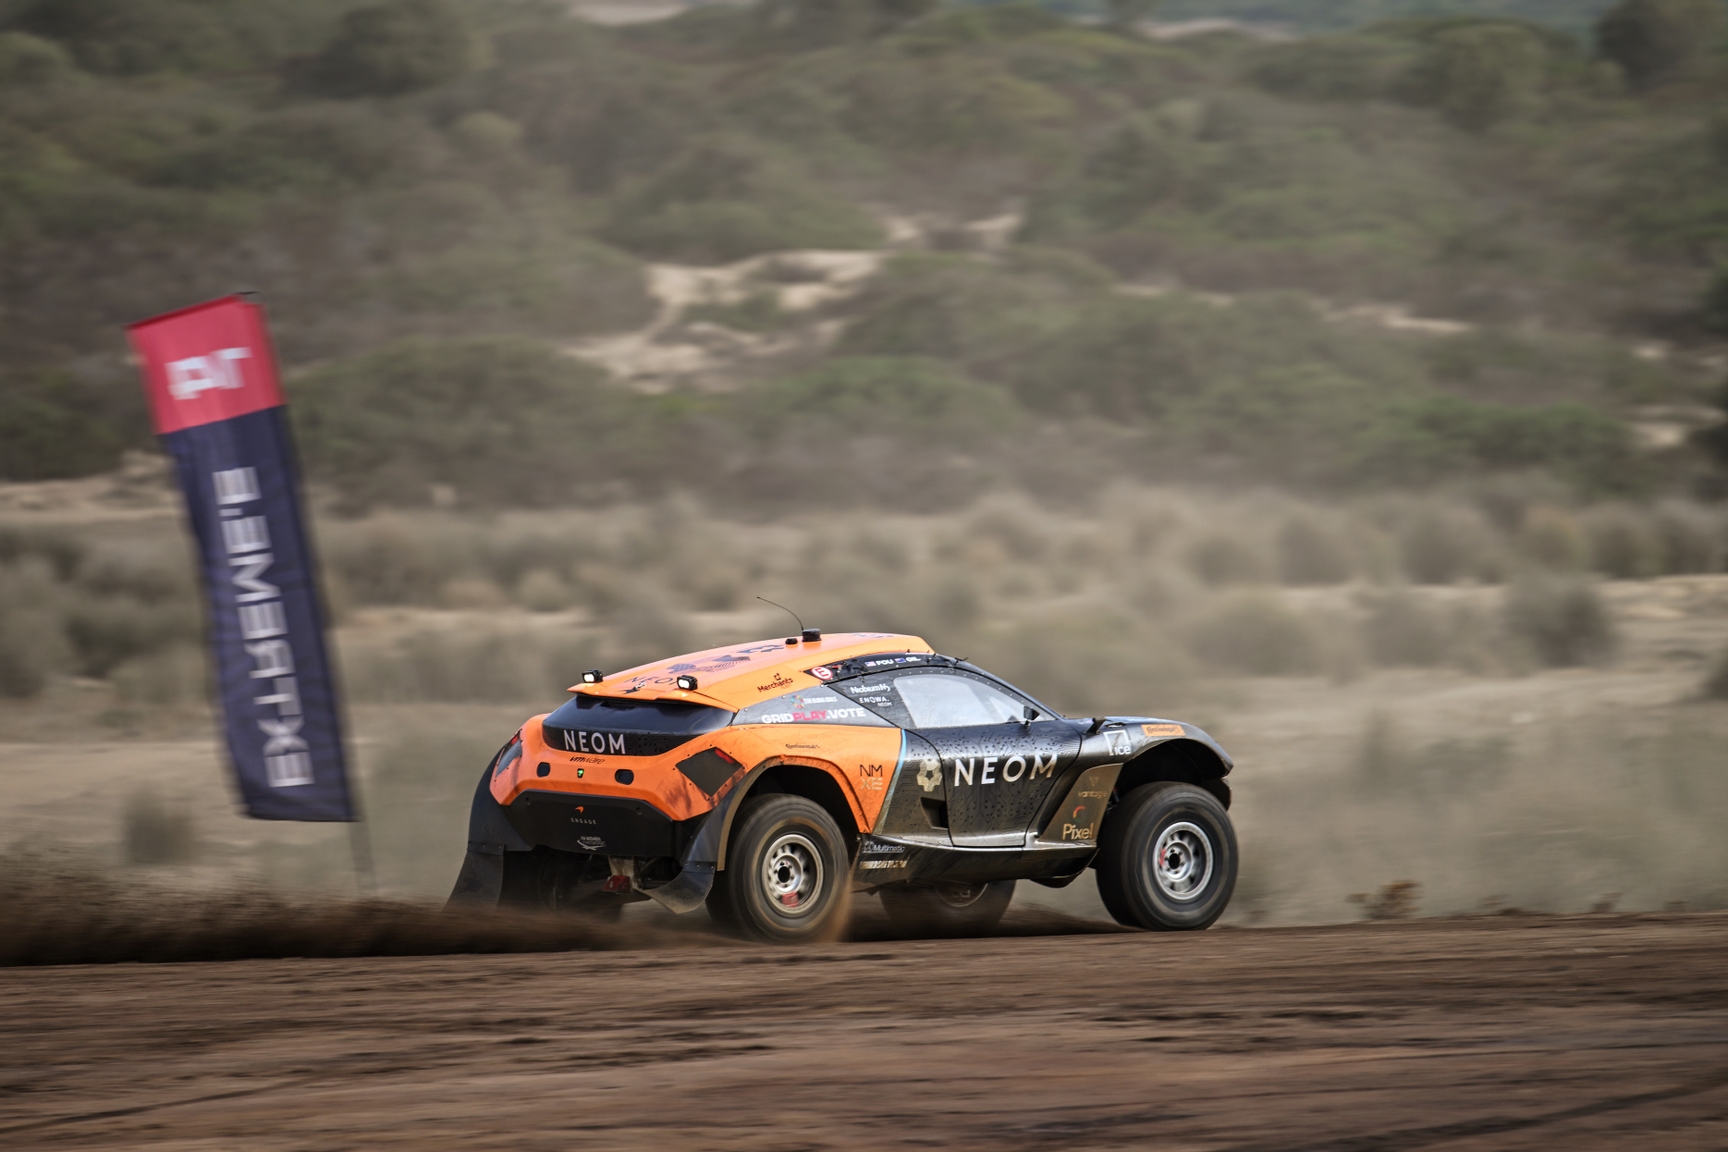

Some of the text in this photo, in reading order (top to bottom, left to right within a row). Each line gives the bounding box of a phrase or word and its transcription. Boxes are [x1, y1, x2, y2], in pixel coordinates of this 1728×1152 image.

[757, 677, 794, 693] Merchants
[563, 730, 626, 755] NEOM
[953, 754, 1057, 787] NEOM
[570, 817, 597, 825] ENGAGE
[1062, 822, 1094, 841] Pixel
